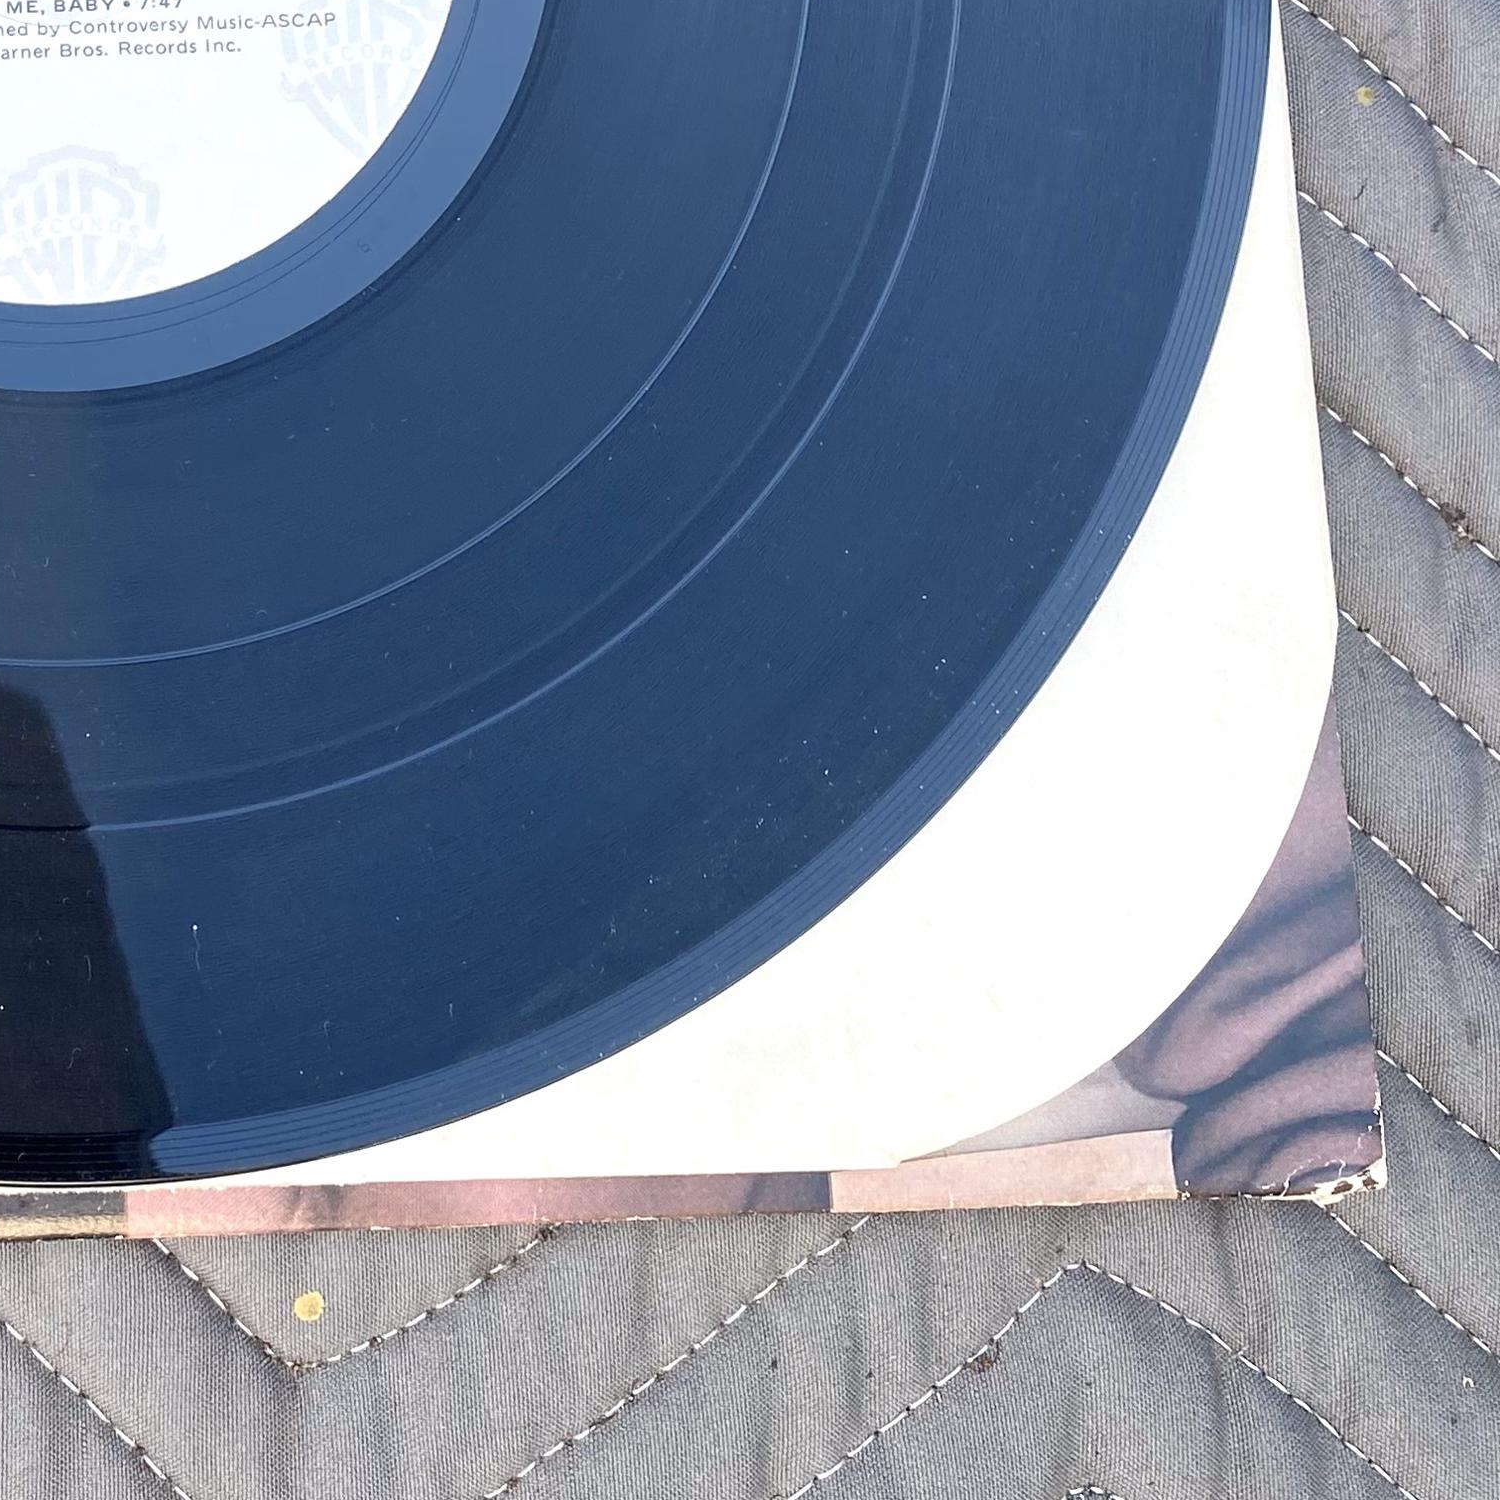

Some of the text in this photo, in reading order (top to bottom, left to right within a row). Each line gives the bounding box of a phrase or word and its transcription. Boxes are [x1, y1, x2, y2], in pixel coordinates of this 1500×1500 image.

[6, 0, 45, 16] ME,
[37, 22, 60, 39] by
[68, 19, 188, 35] Controversy
[197, 12, 336, 30] Music-ASCAP
[59, 43, 108, 58] Bros.
[118, 40, 197, 56] Records
[206, 39, 242, 53] Inc.
